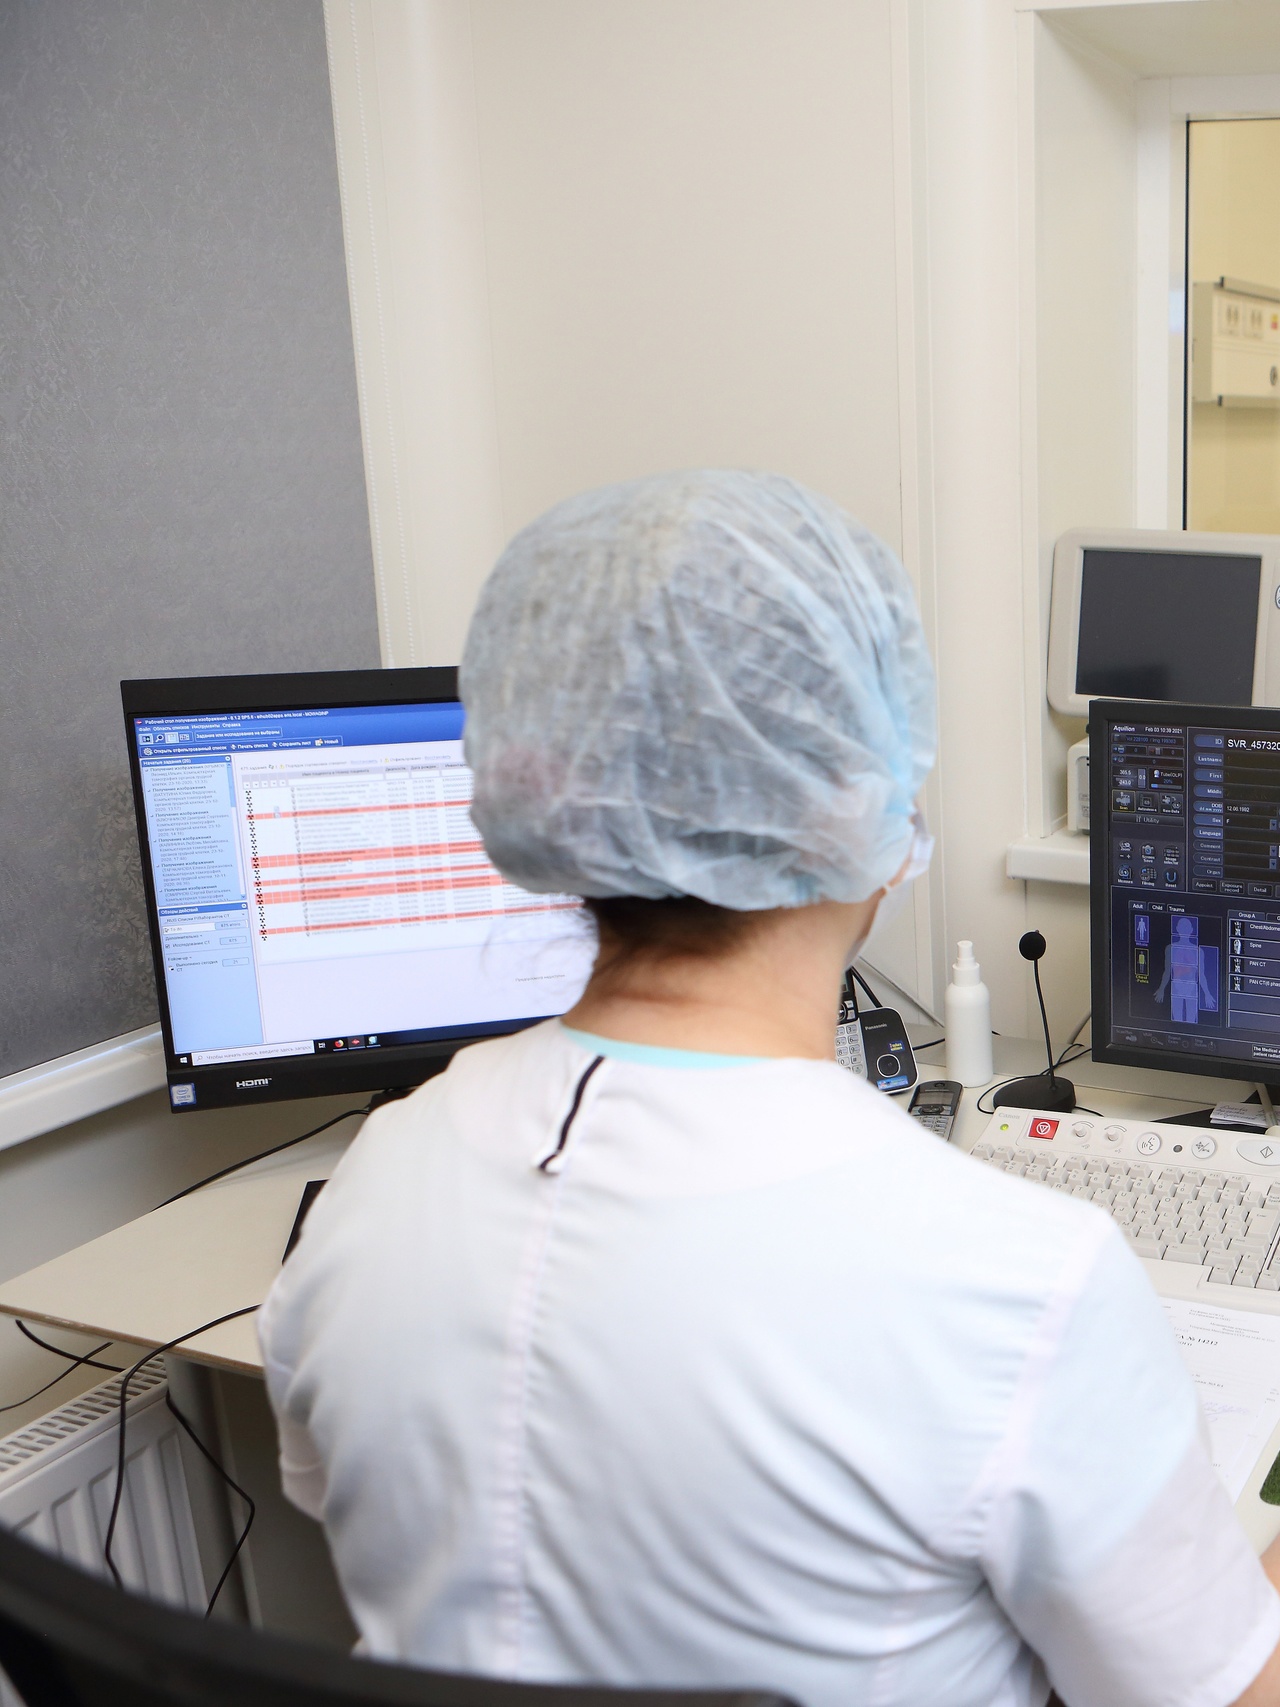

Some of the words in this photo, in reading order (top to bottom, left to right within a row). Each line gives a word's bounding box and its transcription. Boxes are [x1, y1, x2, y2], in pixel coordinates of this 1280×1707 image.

[1113, 725, 1136, 733] Aquilion
[1143, 816, 1160, 824] Utility
[1199, 829, 1222, 837] Language
[864, 1023, 888, 1031] Panasonic
[236, 1078, 269, 1088] HDMI
[998, 1112, 1021, 1120] Canon
